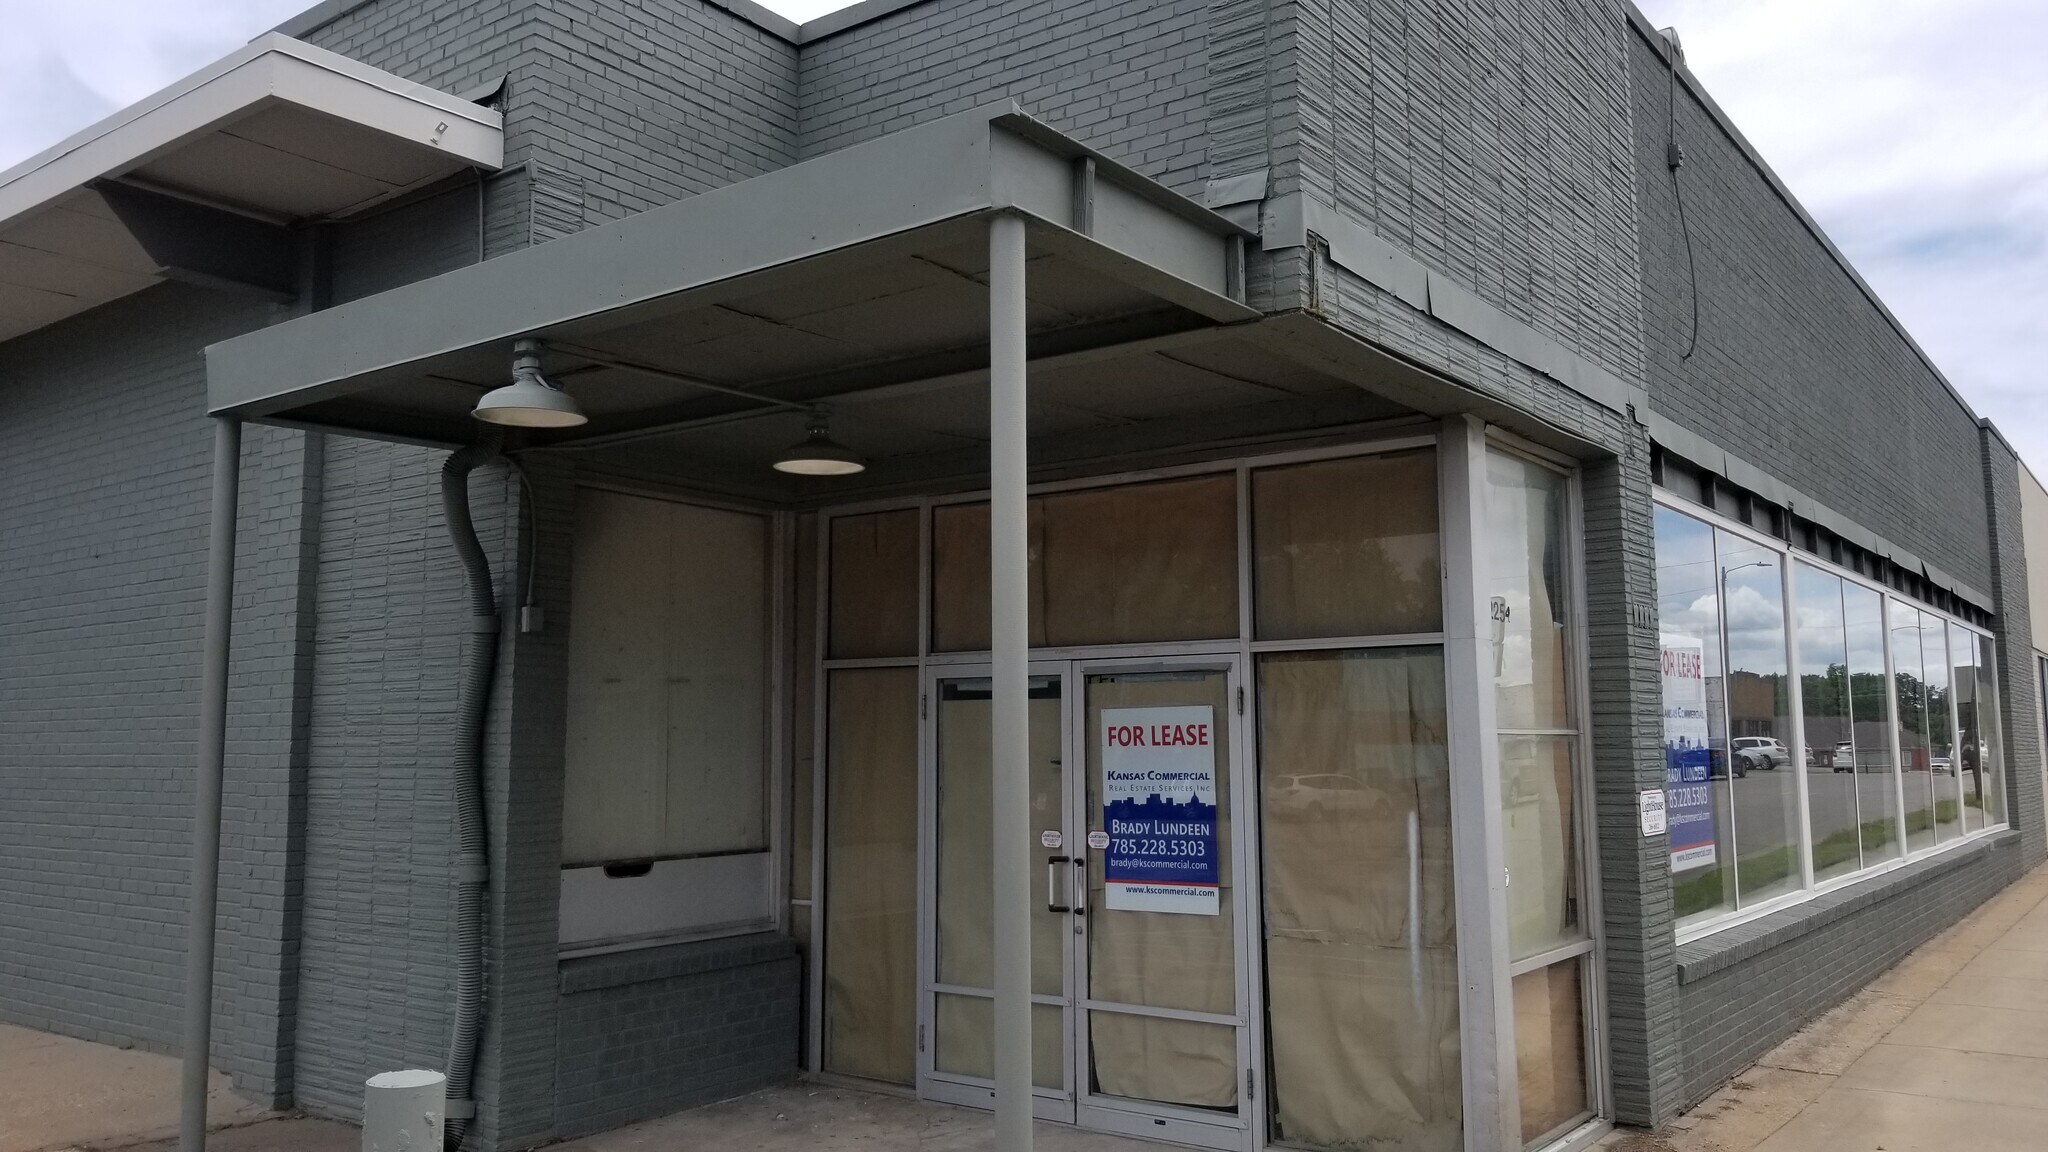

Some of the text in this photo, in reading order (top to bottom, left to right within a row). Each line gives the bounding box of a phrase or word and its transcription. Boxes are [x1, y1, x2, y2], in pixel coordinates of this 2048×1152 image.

[1677, 652, 1701, 680] LEASE
[1664, 708, 1677, 719] ANSAS
[1107, 724, 1209, 747] FOR LEASE
[1107, 770, 1211, 781] KANSAS COMMERCIAL
[1667, 763, 1707, 783] RADY LUNDEEN
[1108, 784, 1127, 792] REAL
[1130, 784, 1156, 792] ESTATE
[1196, 784, 1210, 792] INC
[1112, 819, 1210, 836] BRADY LUNDEEN
[1111, 838, 1205, 857] 785.228.5303
[1110, 857, 1208, 871] brady@kscommercial.com
[1125, 885, 1215, 897] www.kscommercial.com
